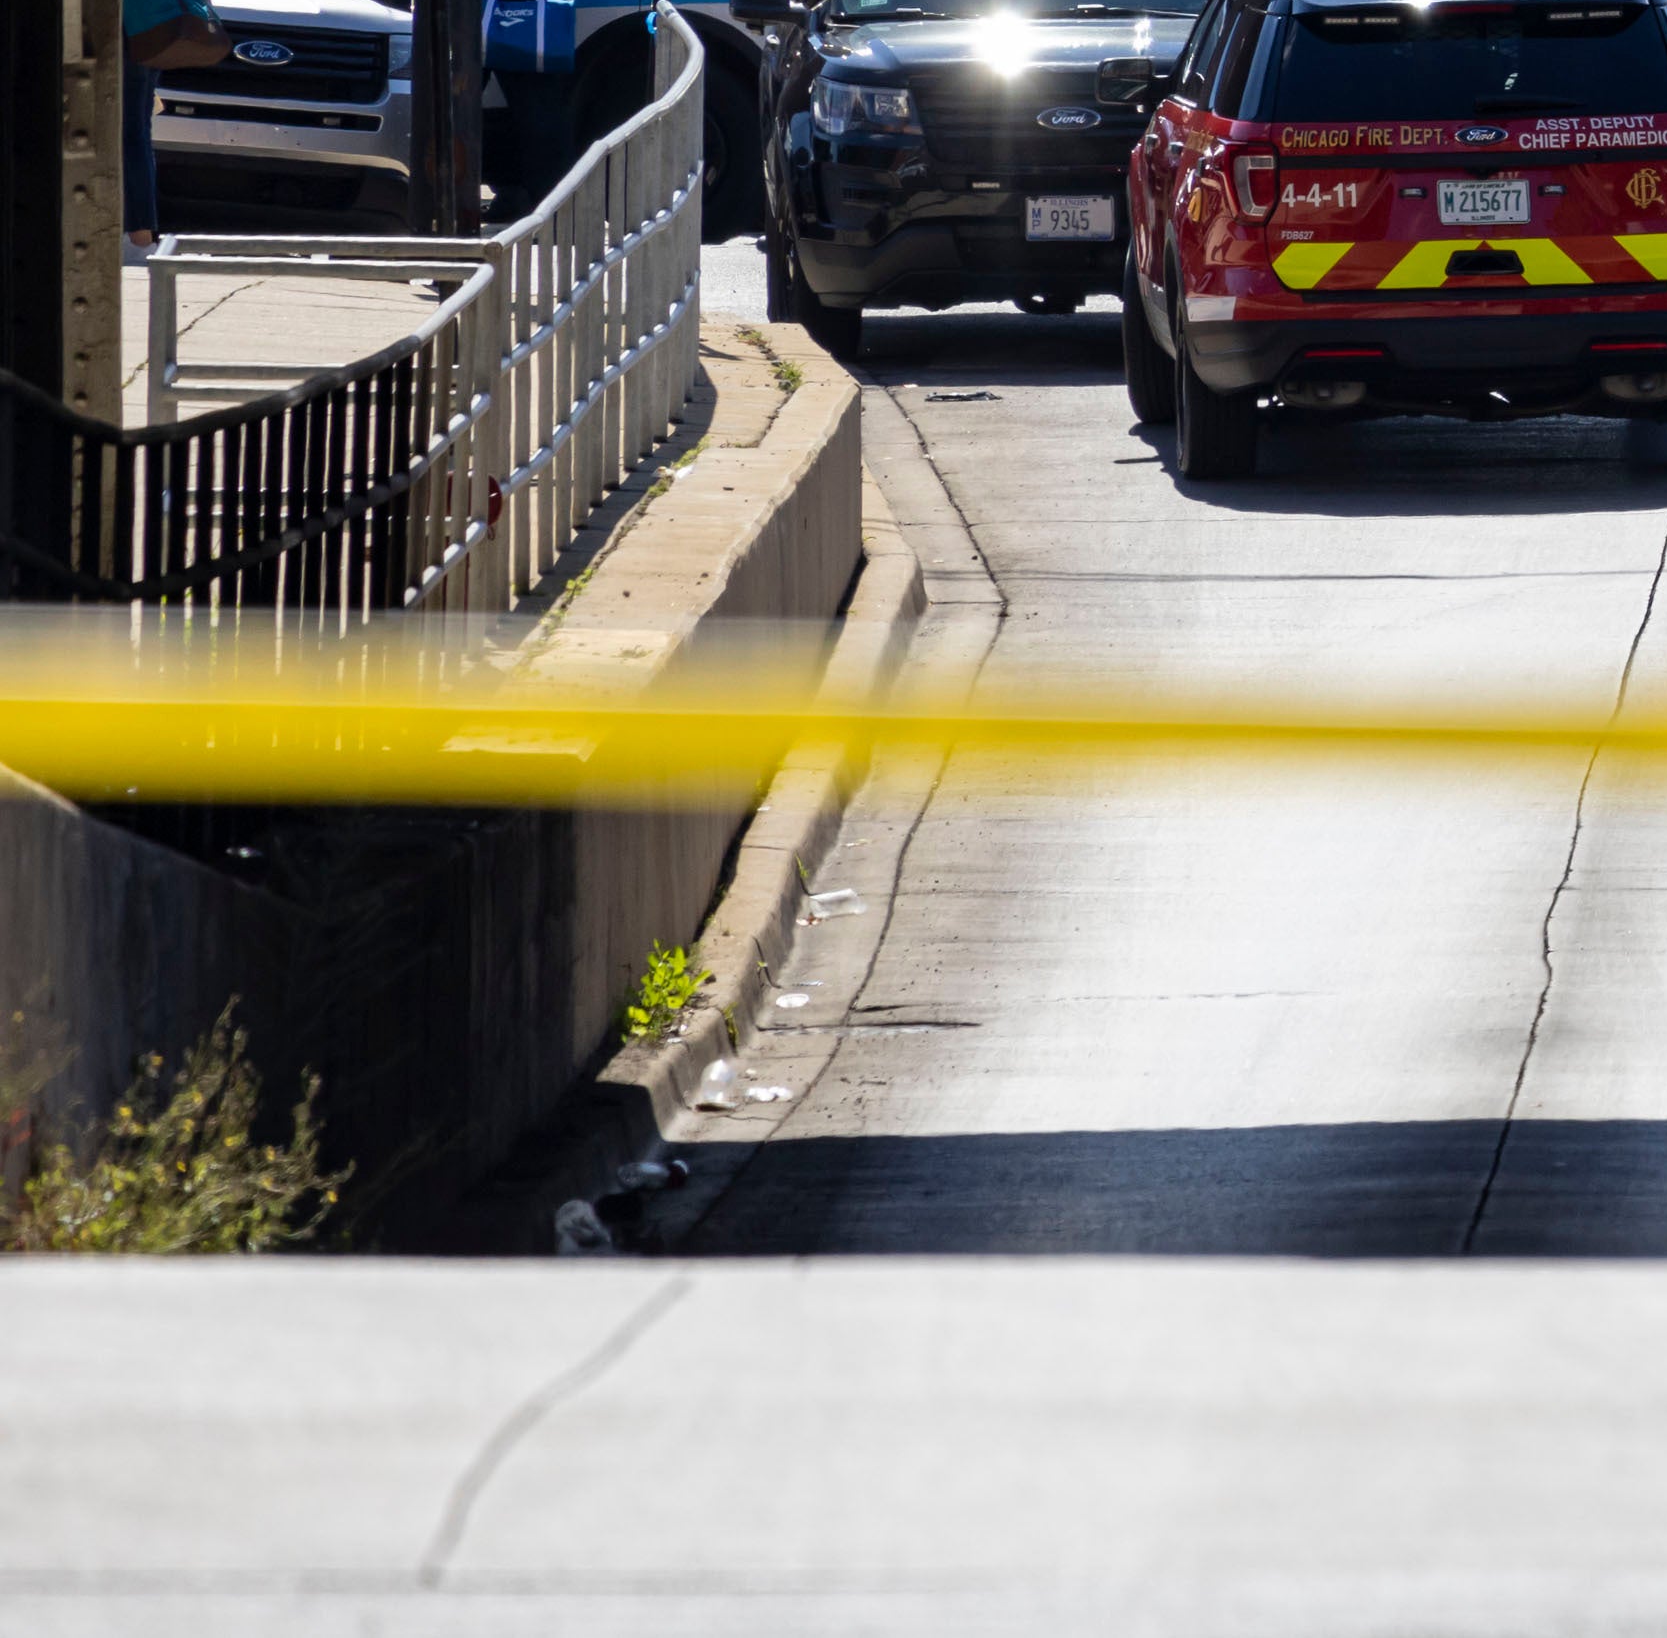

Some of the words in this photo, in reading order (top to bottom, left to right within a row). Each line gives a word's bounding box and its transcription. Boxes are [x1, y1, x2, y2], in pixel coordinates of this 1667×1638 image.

[249, 43, 280, 59] Ford
[1052, 109, 1087, 125] Ford
[1536, 119, 1586, 131] ASST.
[1590, 115, 1655, 130] DEPUTY
[1282, 126, 1350, 148] CHICAGO
[1356, 126, 1393, 146] FIRE
[1400, 125, 1448, 145] DEPT.
[1467, 128, 1496, 142] Ford
[1518, 133, 1571, 149] CHIEF
[1281, 183, 1357, 208] 4-4-11
[1459, 189, 1522, 213] 215677
[1050, 209, 1090, 231] 9345
[1281, 230, 1314, 241] FDB627
